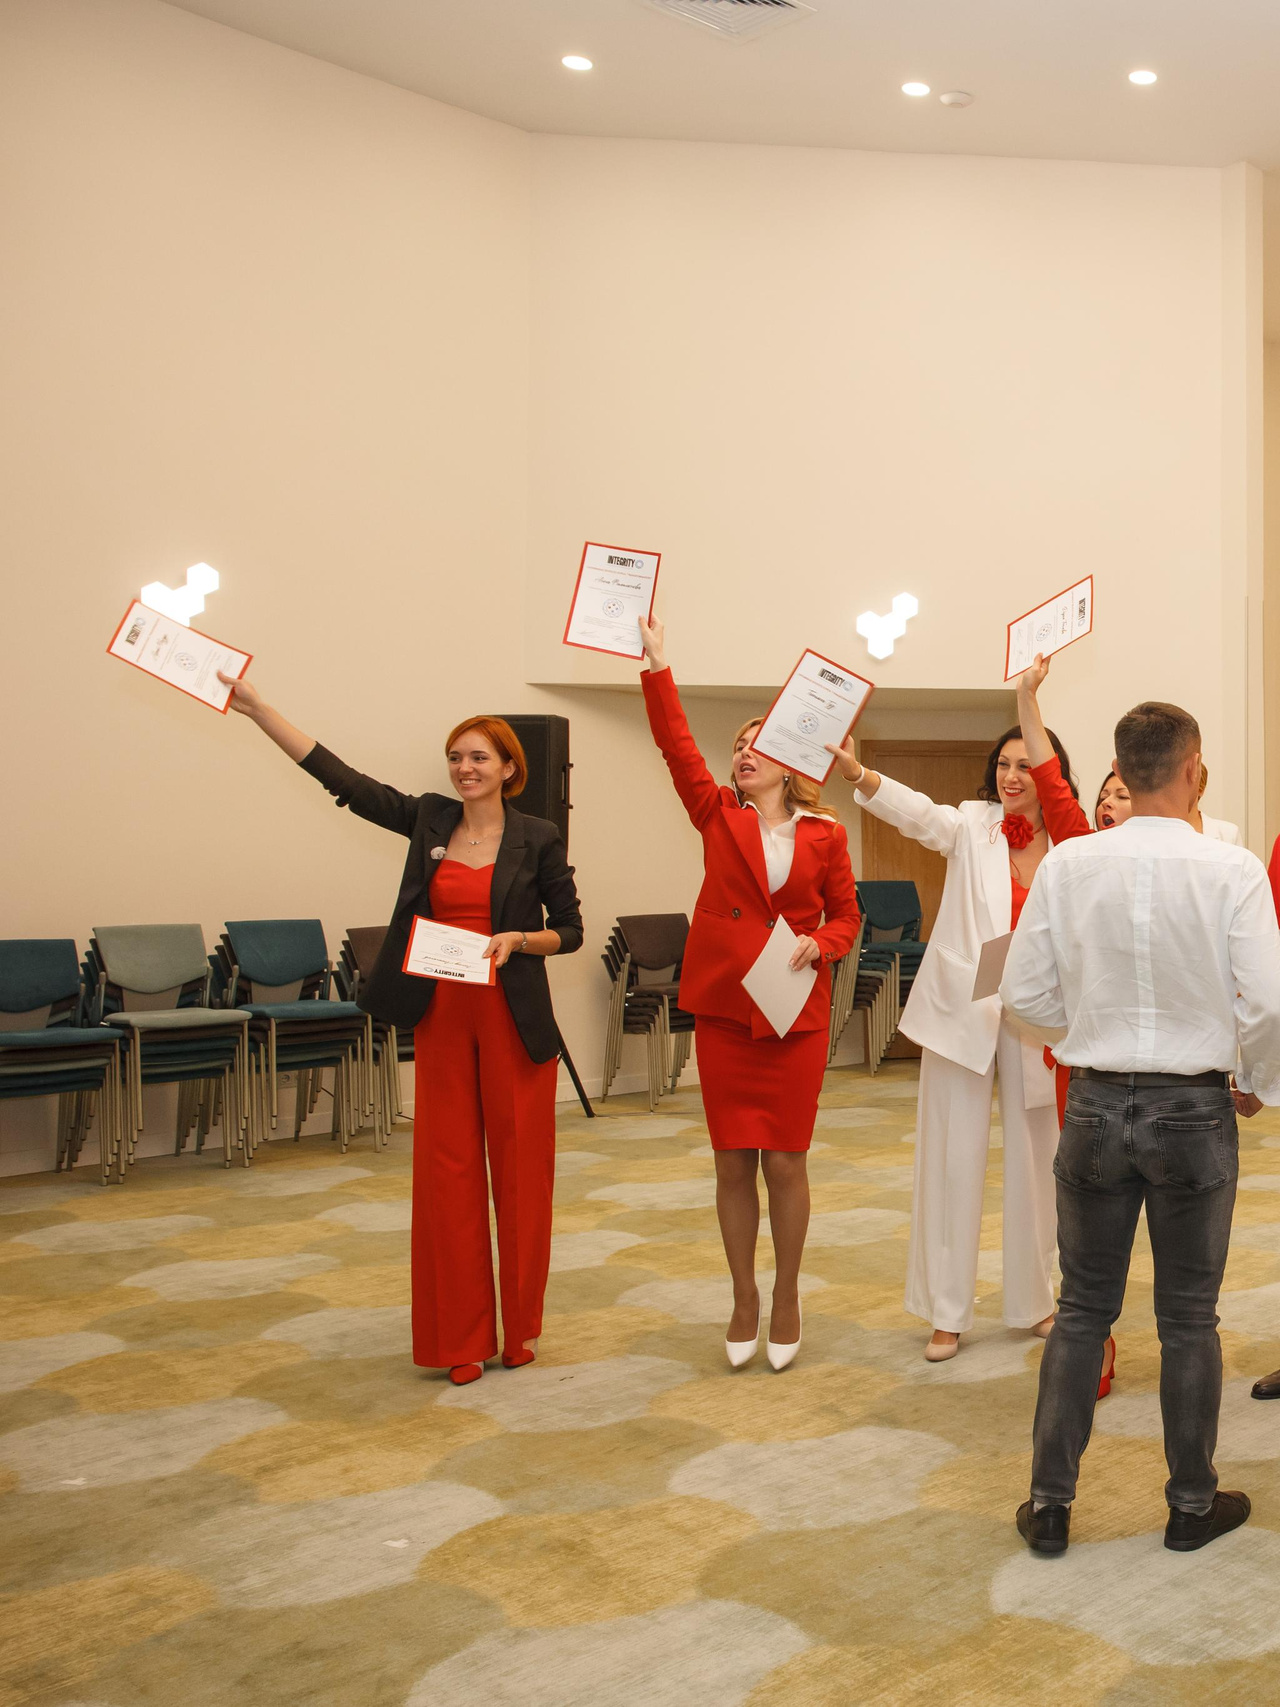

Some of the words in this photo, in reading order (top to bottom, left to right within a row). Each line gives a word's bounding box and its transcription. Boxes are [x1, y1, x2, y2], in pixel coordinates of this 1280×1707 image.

[607, 555, 636, 567] INTEGRITY
[818, 668, 845, 687] INTEGRITY
[434, 968, 465, 978] INTEGRITY
